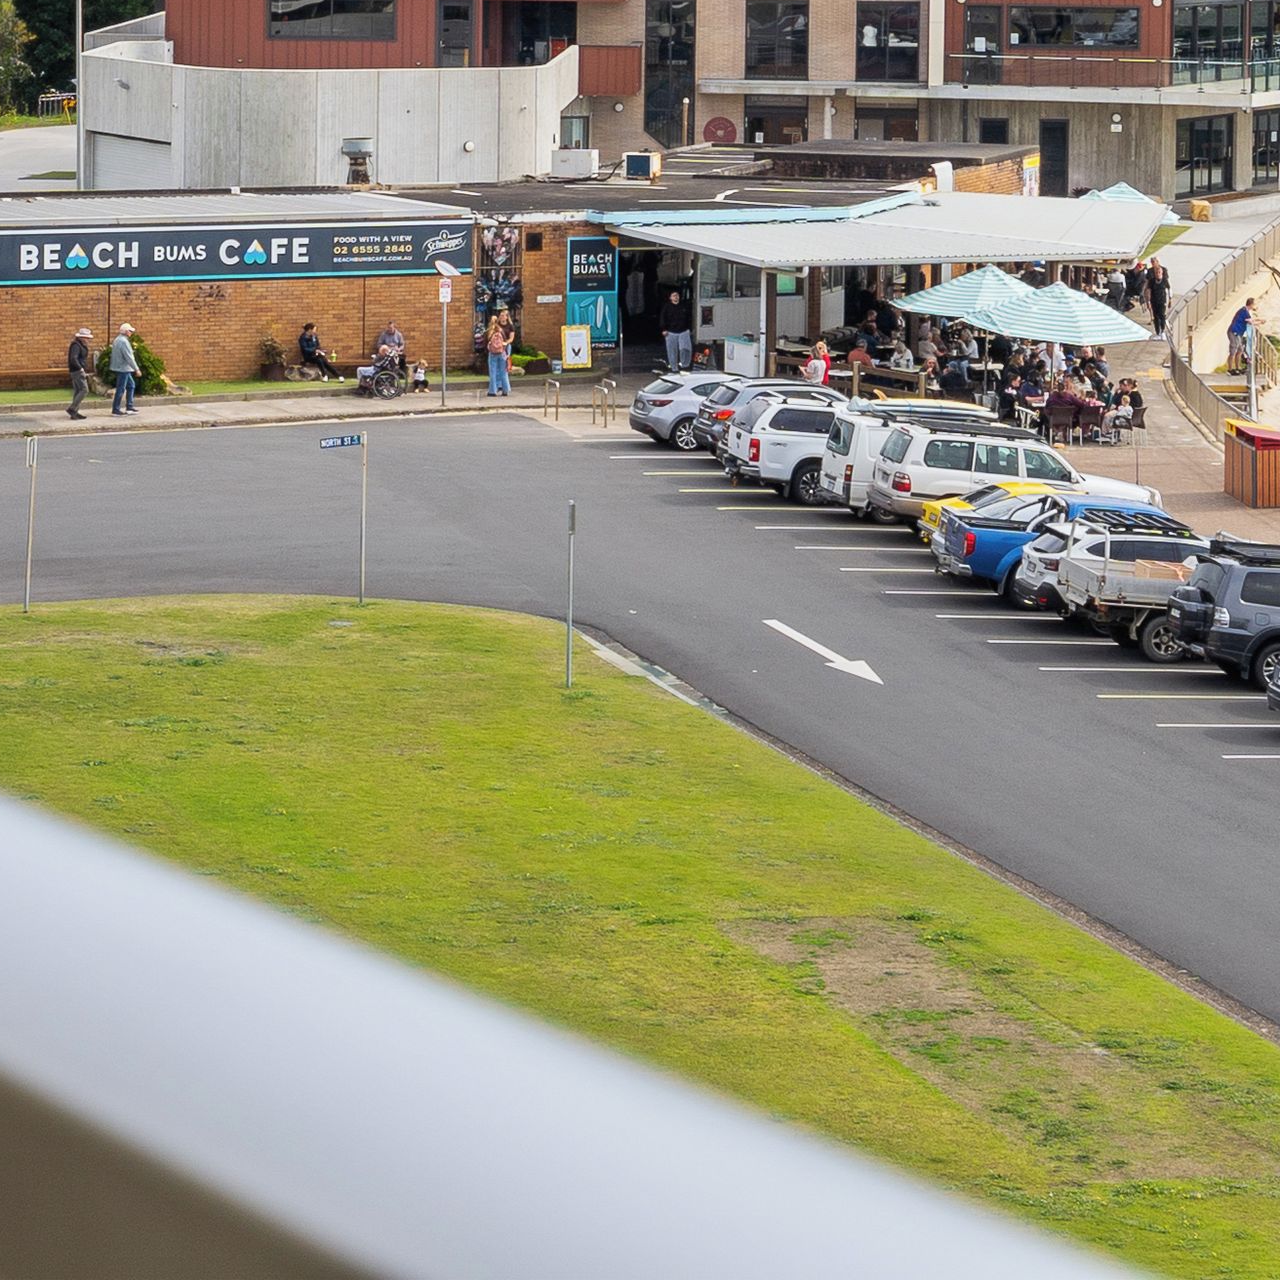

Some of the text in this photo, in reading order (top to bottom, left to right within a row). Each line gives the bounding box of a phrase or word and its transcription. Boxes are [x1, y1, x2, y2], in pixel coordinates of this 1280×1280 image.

[333, 236, 357, 244] FOOD
[358, 235, 381, 243] WITH
[426, 236, 463, 254] Schweppes
[20, 237, 310, 270] BEACH BUMS CAFE
[333, 244, 412, 254] 02 6555 2840
[573, 254, 613, 264] BEACH
[573, 264, 606, 275] BUMS
[321, 436, 351, 447] NORTH ST
